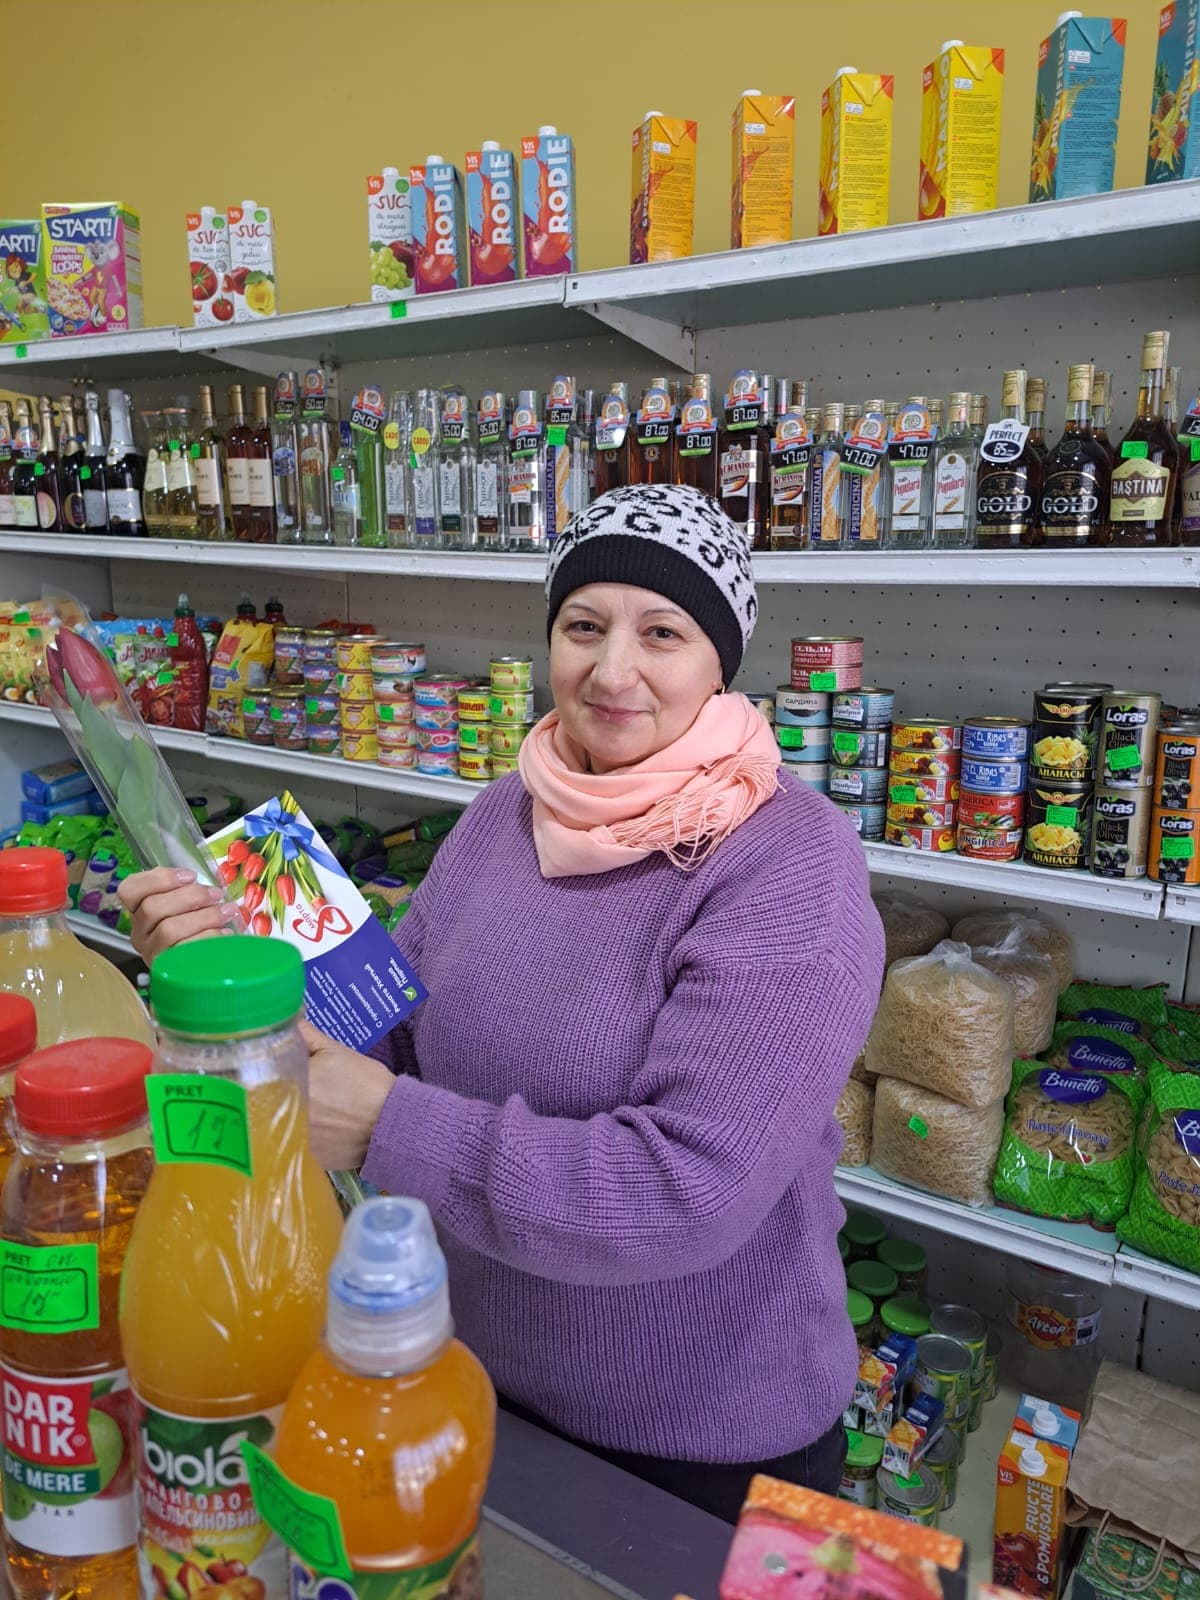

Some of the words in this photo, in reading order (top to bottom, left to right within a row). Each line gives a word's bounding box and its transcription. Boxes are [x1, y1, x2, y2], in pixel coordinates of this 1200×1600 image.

[1180, 0, 1197, 121] MULTIFRUC
[547, 138, 569, 234] RODIE
[375, 194, 406, 210] SUC
[490, 153, 512, 245] RODIE
[433, 167, 454, 256] RODIE
[51, 217, 112, 238] START!
[236, 223, 266, 238] SUC
[0, 234, 36, 253] ART!
[53, 261, 82, 274] LOOPS
[352, 410, 379, 430] 84.00
[733, 408, 757, 422] 87.00
[645, 424, 669, 437] 87.00
[990, 430, 1023, 441] PERFECT
[516, 436, 537, 450] 87.00
[687, 435, 711, 448] 87.00
[899, 446, 928, 459] 47.00
[994, 443, 1009, 456] 85
[782, 450, 808, 465] 47.00
[844, 449, 876, 467] 47.00
[977, 495, 1032, 513] GOLD
[1042, 495, 1098, 513] GOLD
[786, 698, 818, 706] САРДИНА
[1106, 708, 1147, 723] Loras
[1111, 731, 1136, 742] Black
[1164, 742, 1195, 755] Loras
[1039, 767, 1086, 780] АНАНАСЫ
[1097, 800, 1134, 814] Loras
[1100, 821, 1123, 832] Black
[1161, 817, 1193, 829] Loras
[1098, 830, 1124, 841] Olives
[1032, 853, 1078, 865] АНАНАСЫ
[291, 905, 353, 943] 8
[363, 963, 385, 989] Усатый
[388, 956, 409, 984] Партия.
[387, 967, 404, 989] Наша
[348, 982, 380, 1022] праздником!
[380, 987, 401, 1013] Ренато
[1071, 1043, 1131, 1071] Bunetto
[1044, 1071, 1101, 1095] Bunetto
[165, 1084, 204, 1098] PRET
[1026, 1118, 1058, 1133] Paste
[1158, 1171, 1187, 1192] Paste
[4, 1250, 32, 1265] PRET
[3, 1381, 75, 1425] DAR
[5, 1412, 76, 1457] NIK
[3, 1455, 24, 1482] DE
[26, 1470, 88, 1492] MERE
[1000, 1468, 1014, 1480] VIS
[1025, 1478, 1041, 1534] FRUCTE
